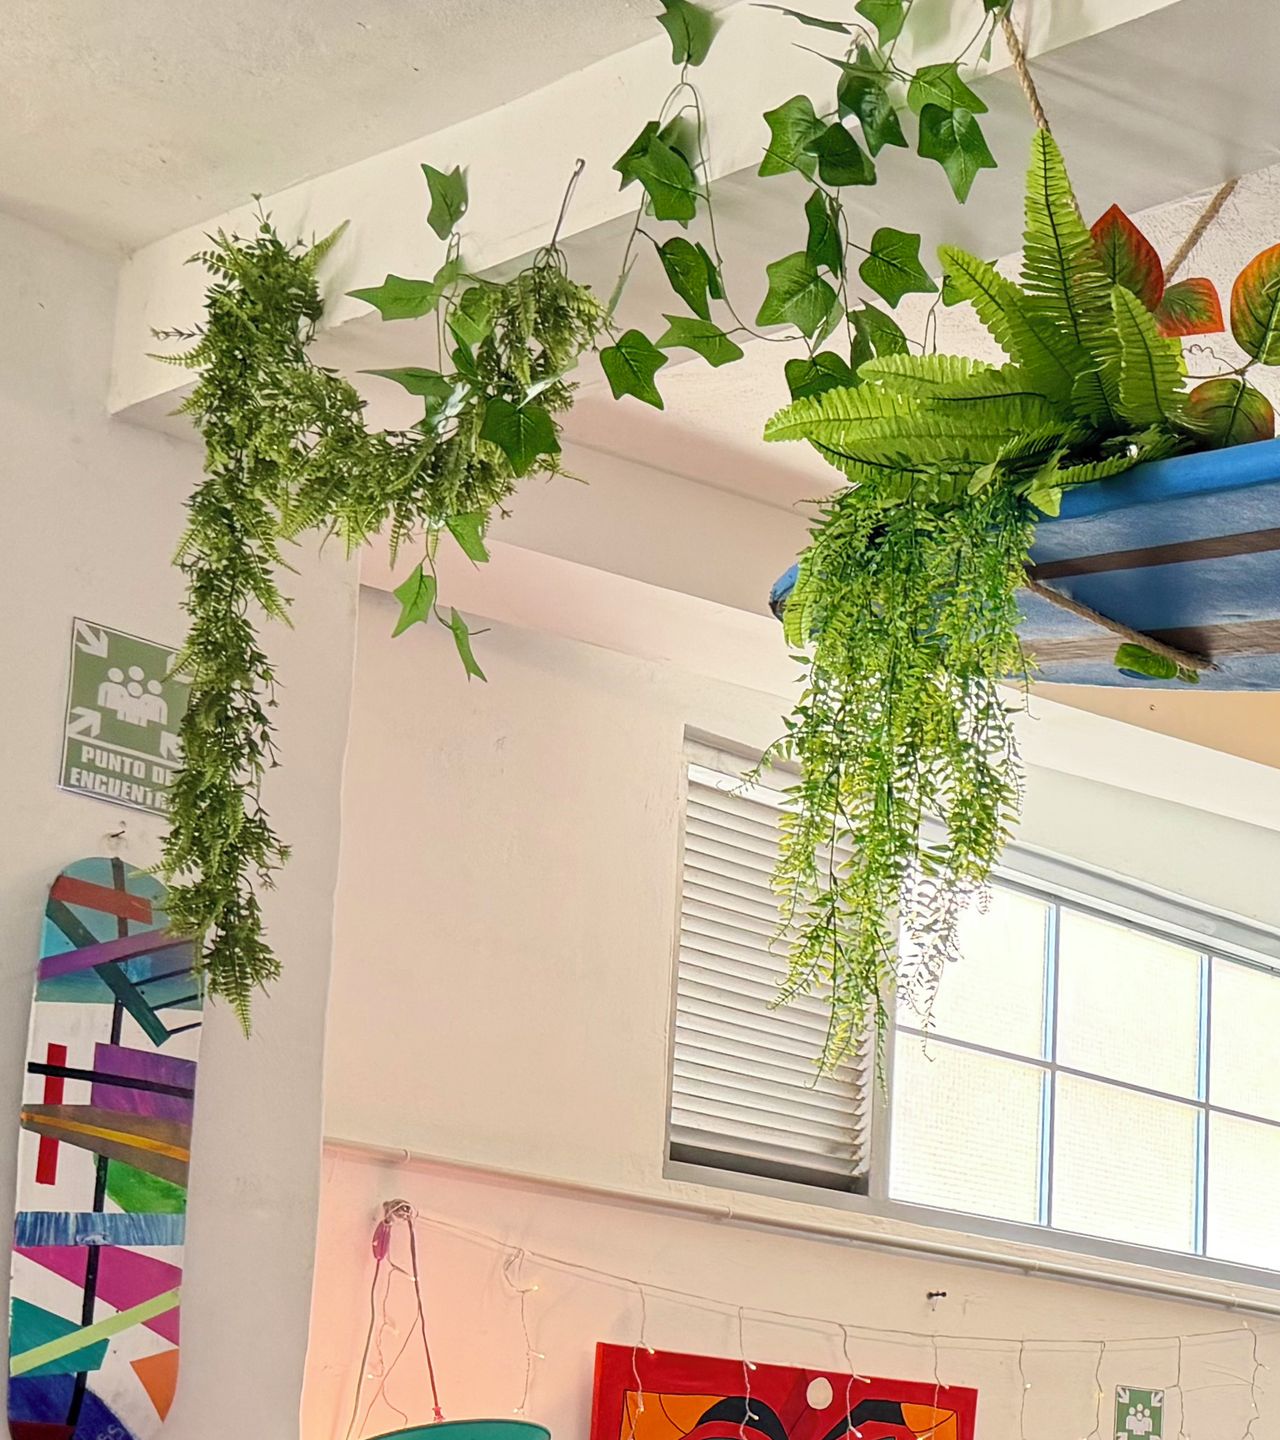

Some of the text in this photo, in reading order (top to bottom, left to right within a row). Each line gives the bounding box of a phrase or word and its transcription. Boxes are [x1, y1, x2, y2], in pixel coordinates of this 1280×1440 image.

[81, 745, 173, 786] PUNTO DE
[70, 767, 172, 812] ENCUENTR
